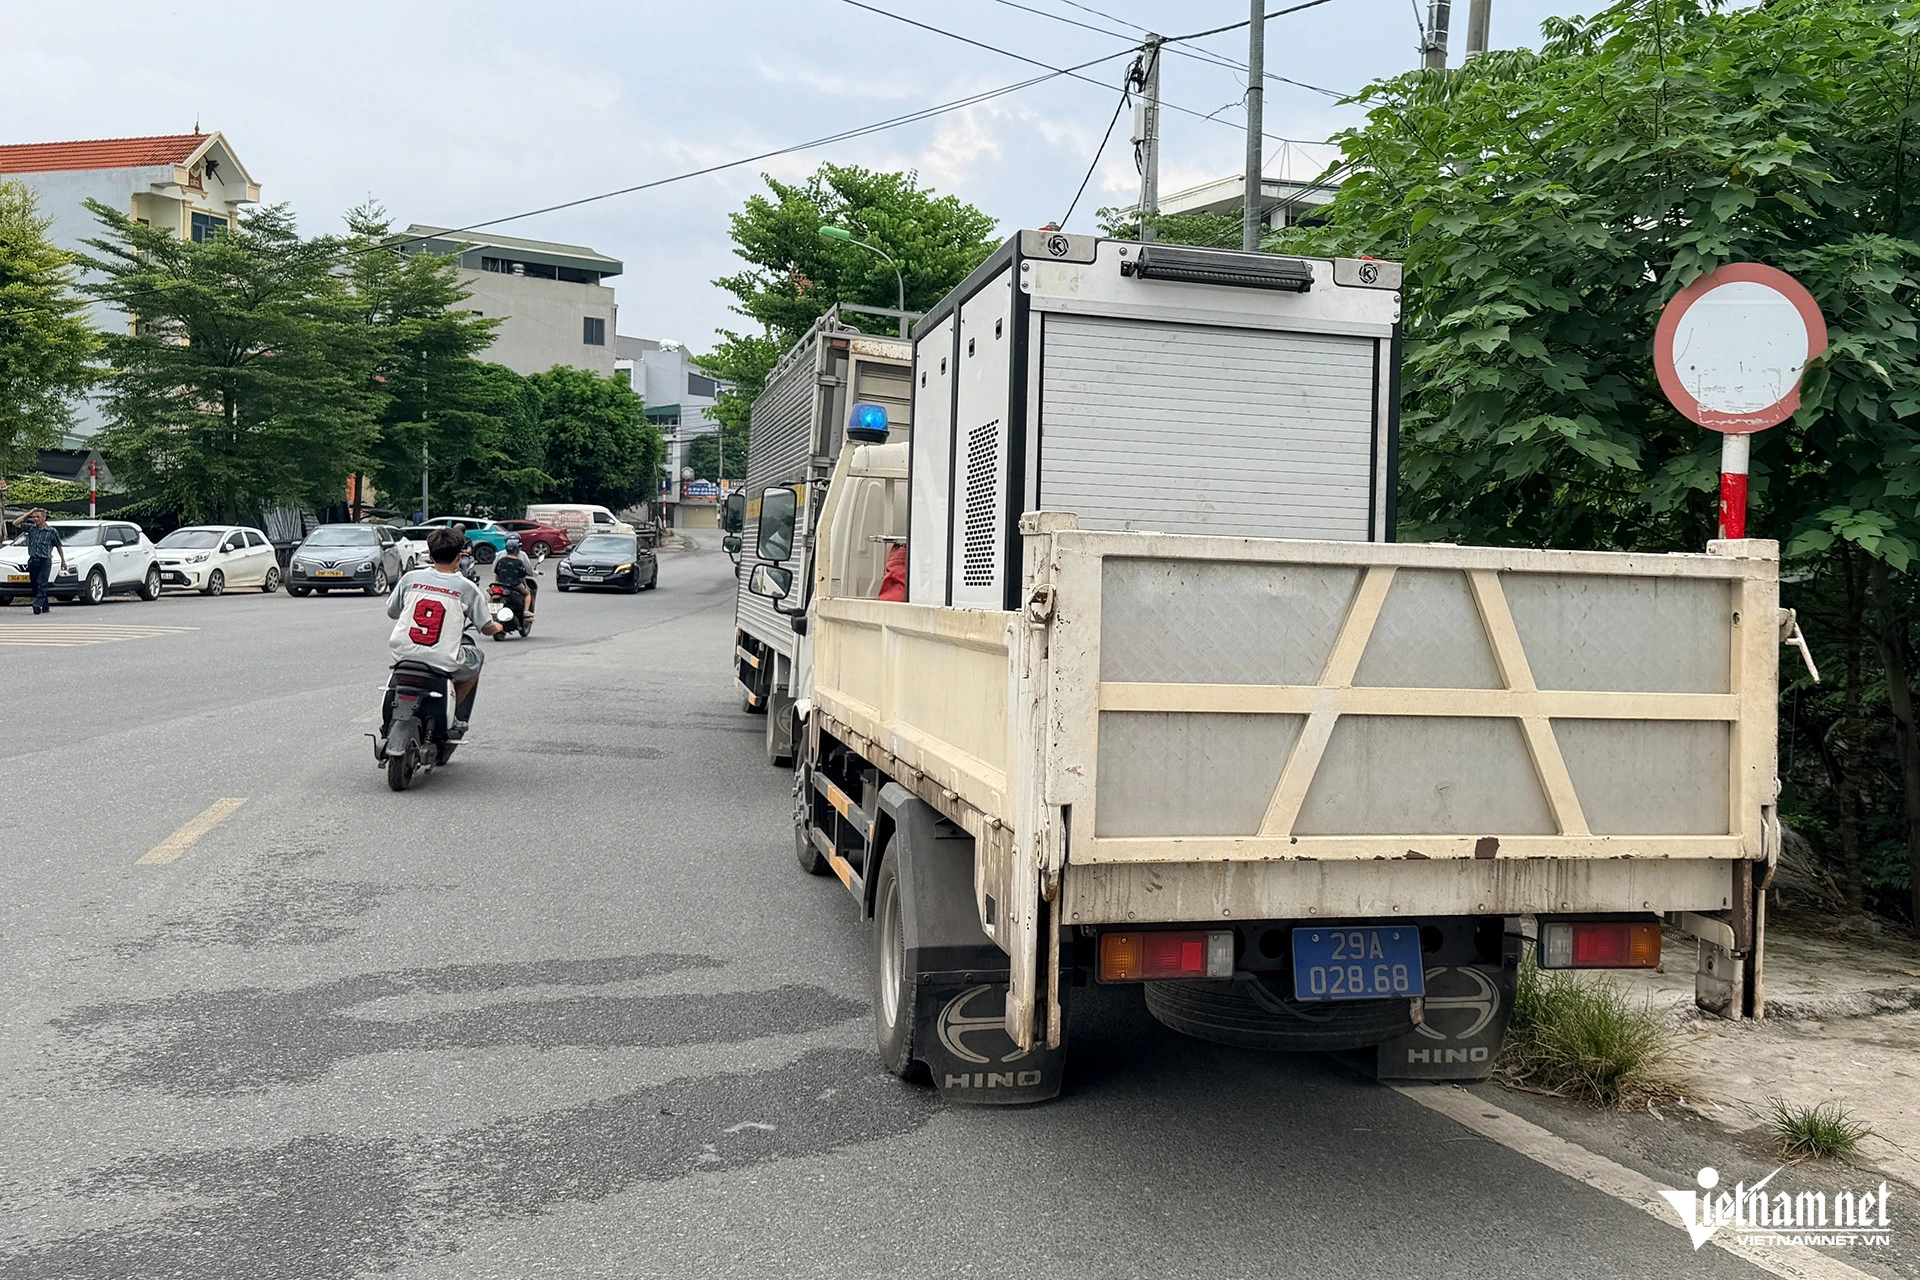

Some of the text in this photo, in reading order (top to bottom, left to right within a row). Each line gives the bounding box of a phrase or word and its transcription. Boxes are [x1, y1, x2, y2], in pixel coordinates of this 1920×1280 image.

[408, 598, 447, 647] 9
[1330, 931, 1384, 960] 29A
[1310, 964, 1410, 994] 028.68
[1407, 1046, 1489, 1063] HINO
[944, 1070, 1042, 1089] HINO
